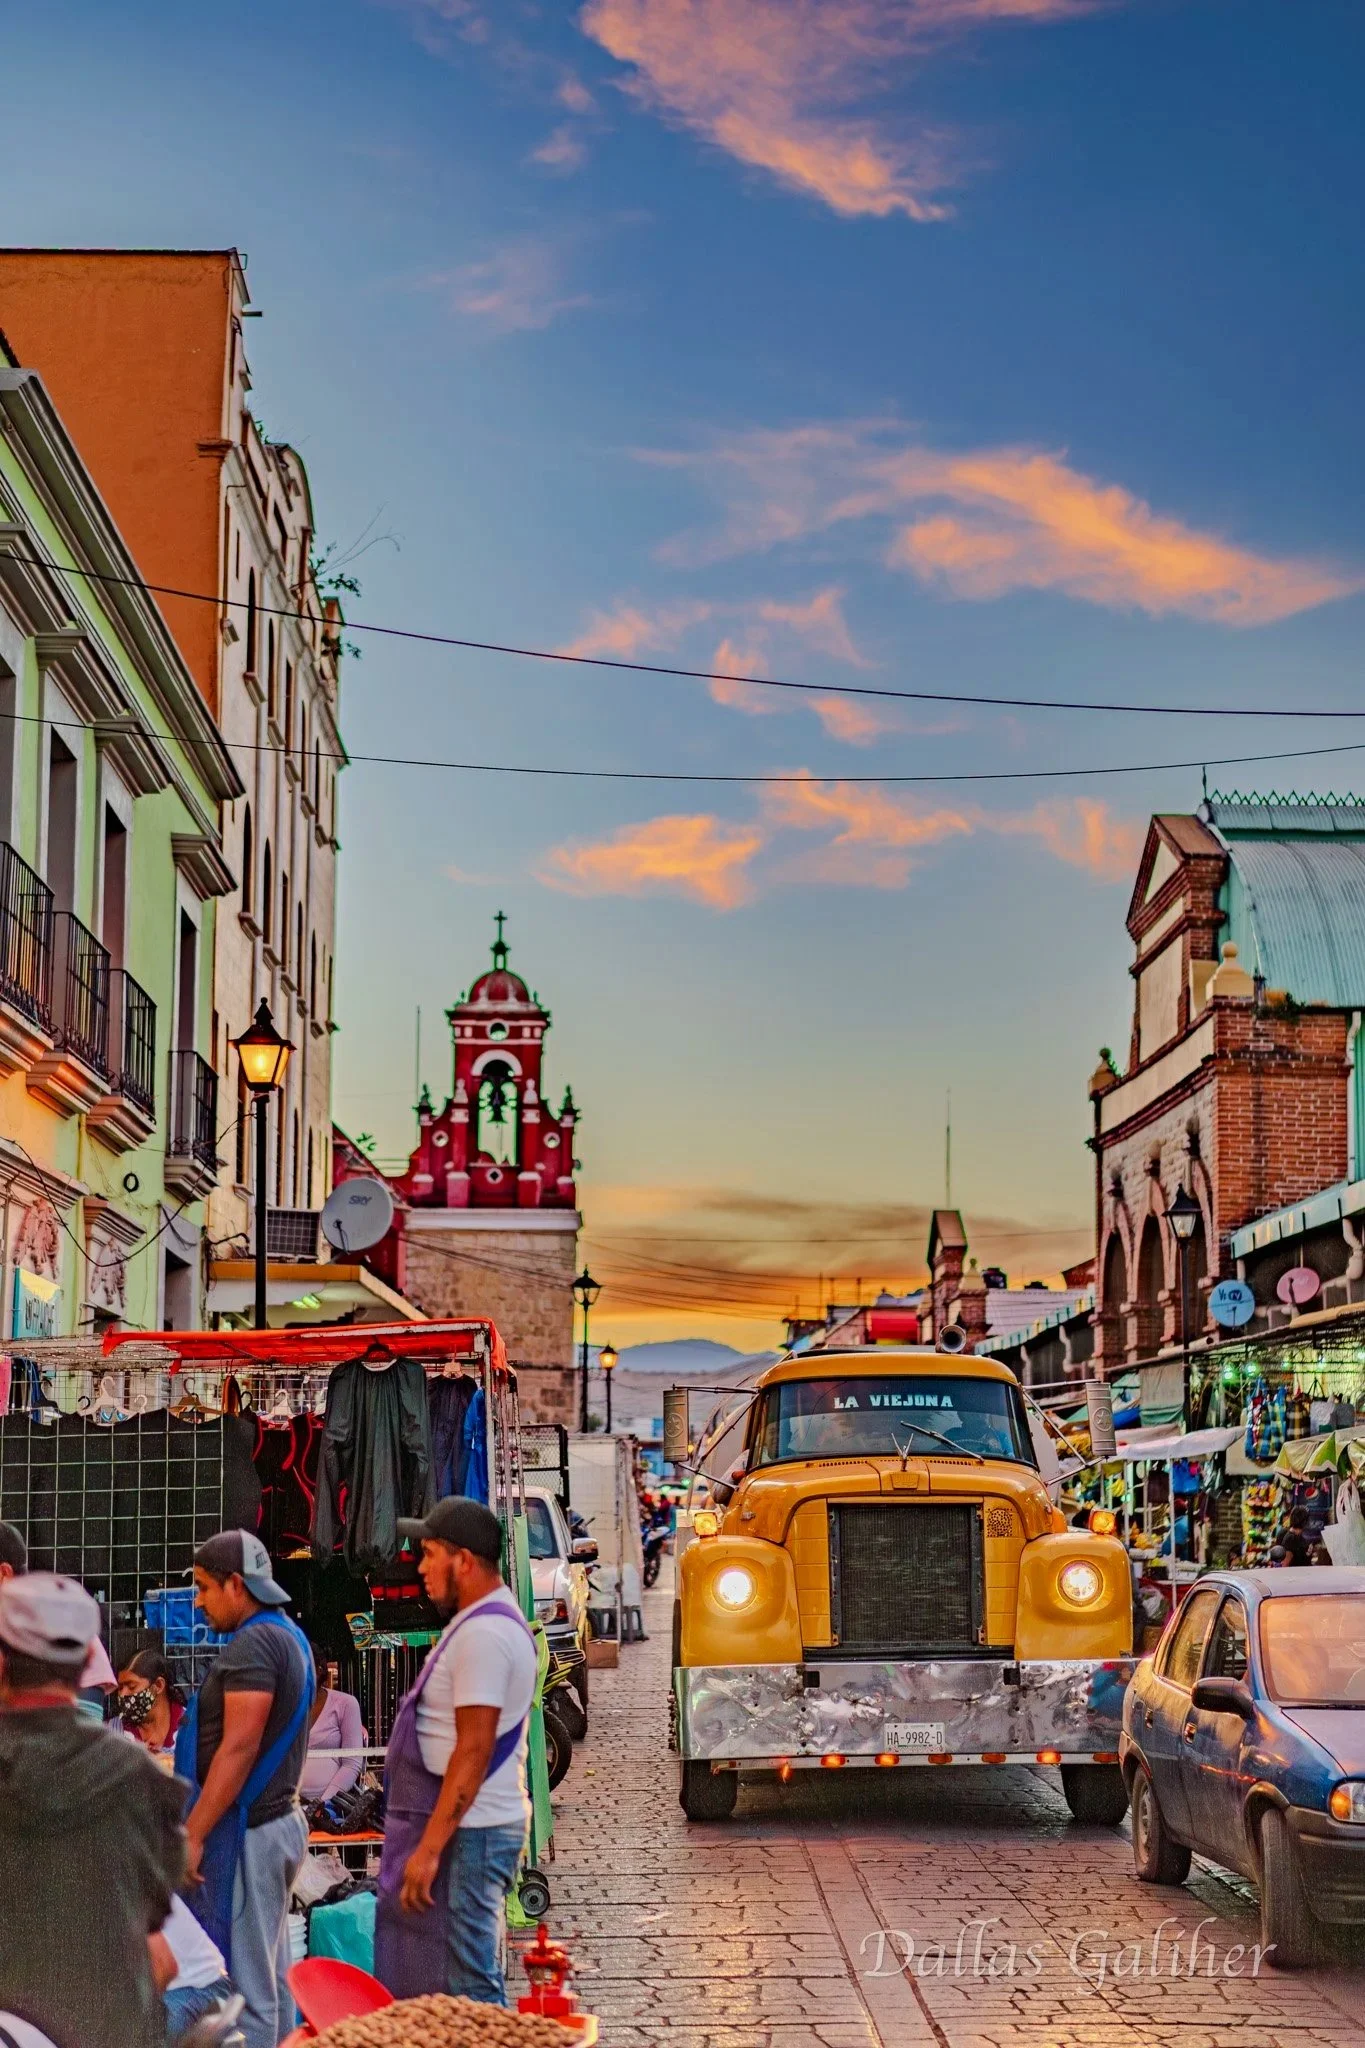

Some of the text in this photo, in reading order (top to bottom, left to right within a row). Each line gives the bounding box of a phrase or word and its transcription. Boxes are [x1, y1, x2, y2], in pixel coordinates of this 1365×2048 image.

[834, 1395, 953, 1409] LA VIEJONA
[887, 1731, 942, 1745] HA-9982-D
